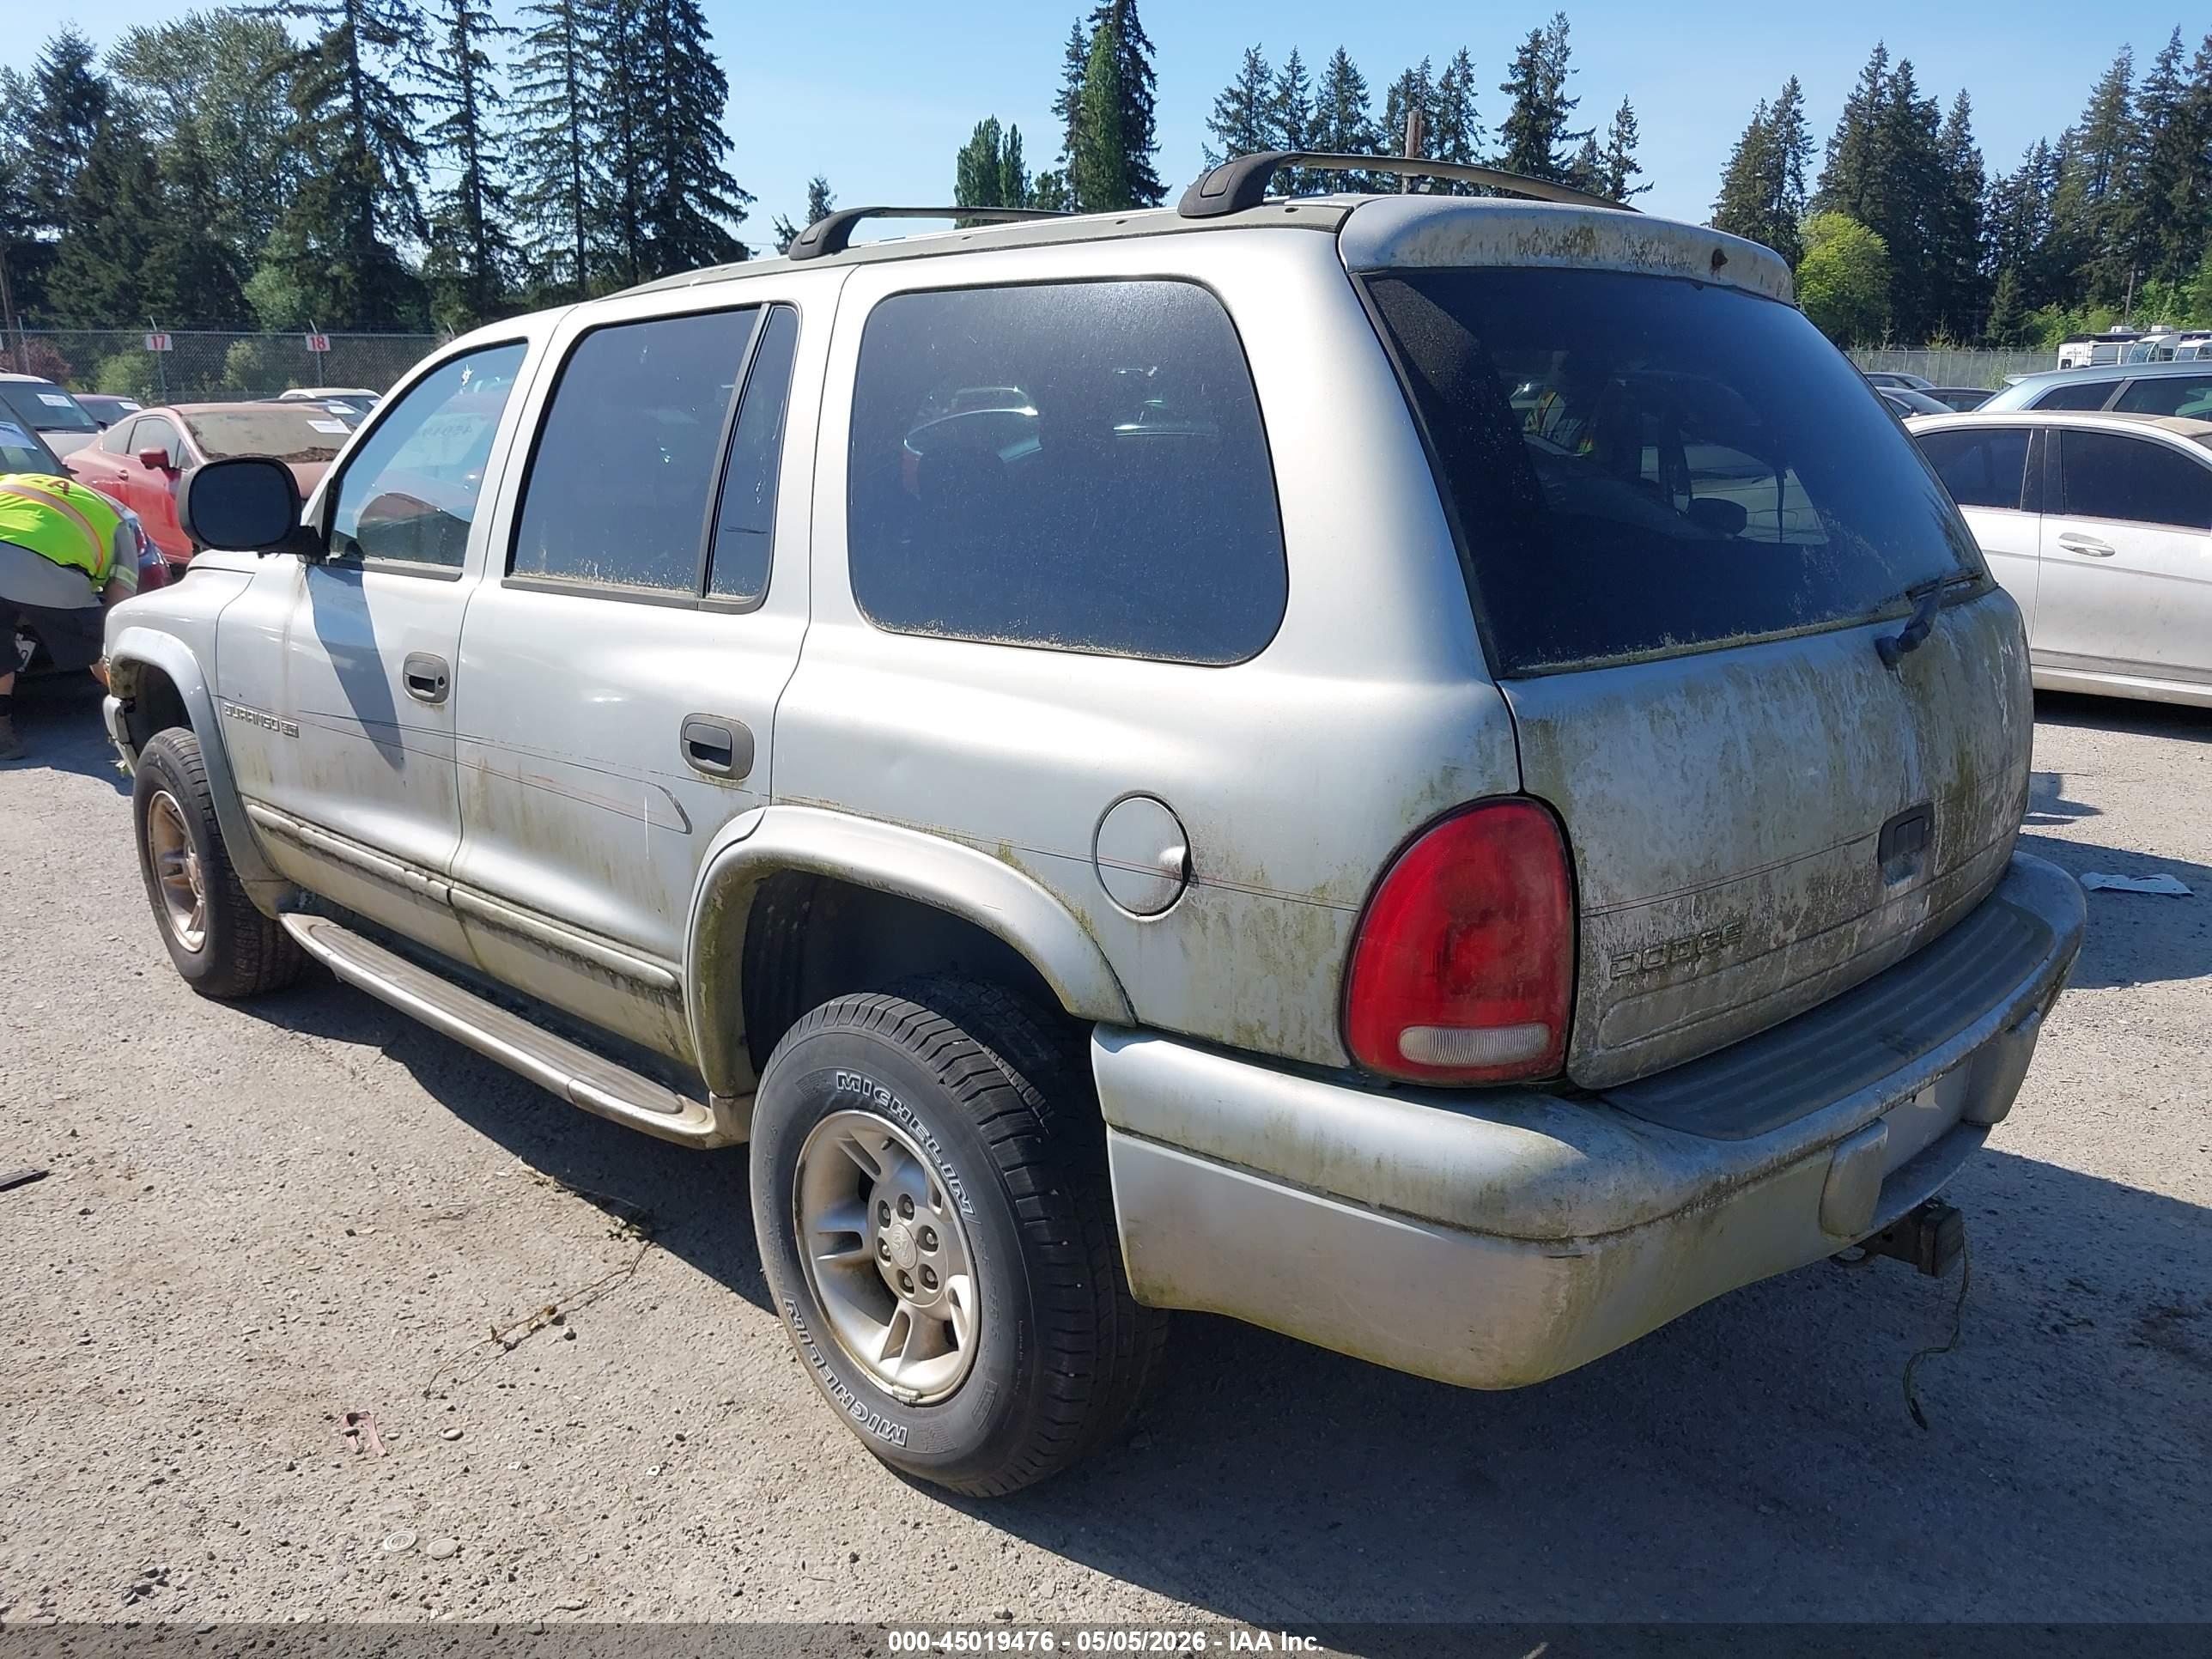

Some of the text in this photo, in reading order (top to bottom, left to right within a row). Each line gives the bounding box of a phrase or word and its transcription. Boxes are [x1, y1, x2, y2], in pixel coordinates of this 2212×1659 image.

[151, 335, 165, 349] 17
[310, 336, 326, 350] 18
[1610, 921, 1743, 981] DODGE
[836, 1071, 975, 1217] MICHELIN
[782, 1297, 908, 1448] MICHELIN
